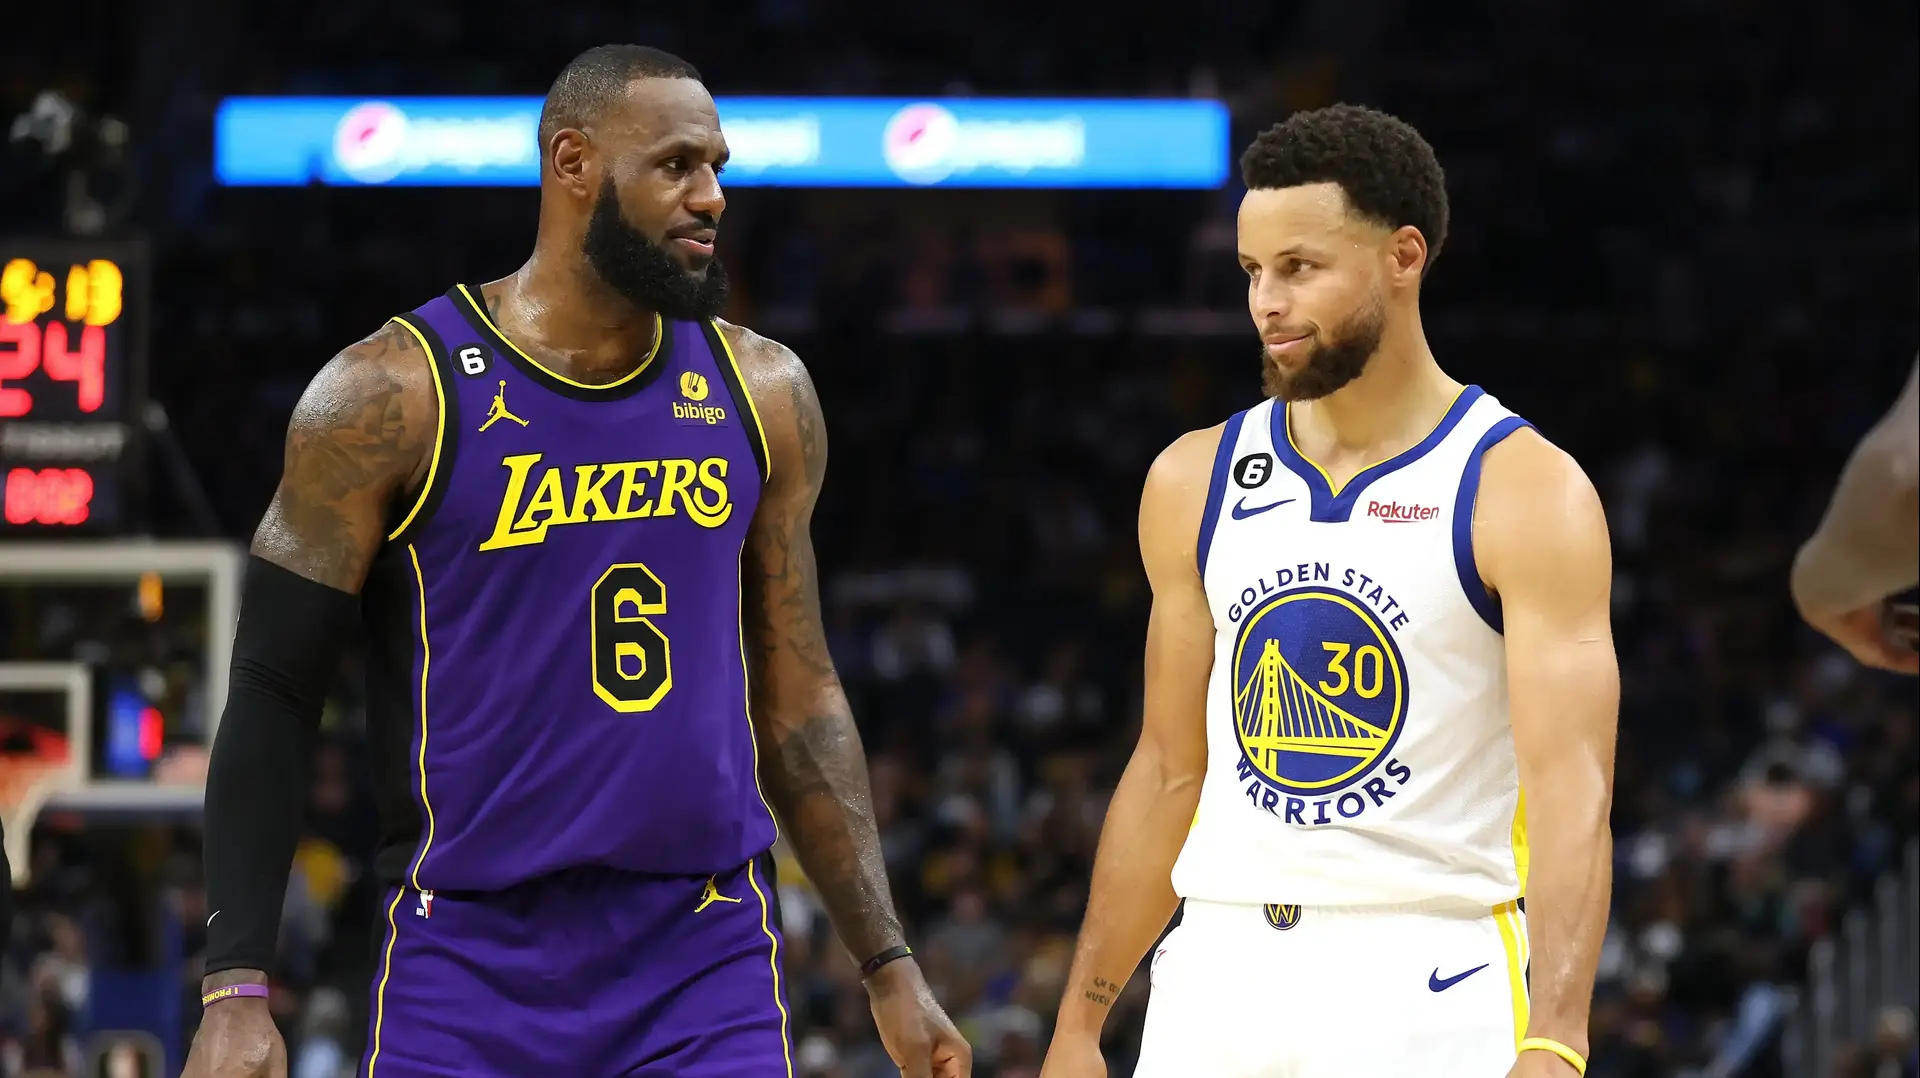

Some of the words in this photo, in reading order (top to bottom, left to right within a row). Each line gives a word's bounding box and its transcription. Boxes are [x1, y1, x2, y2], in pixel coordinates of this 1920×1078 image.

[459, 347, 486, 375] 6
[672, 402, 726, 425] bibigo
[1241, 458, 1267, 485] 6
[478, 452, 733, 552] LAKERS
[1367, 501, 1439, 521] Rakuten
[1228, 562, 1330, 623] GOLDEN
[1342, 568, 1409, 631] STATE
[590, 562, 673, 713] 6
[1318, 641, 1384, 699] 30
[1236, 753, 1411, 825] WARRIORS
